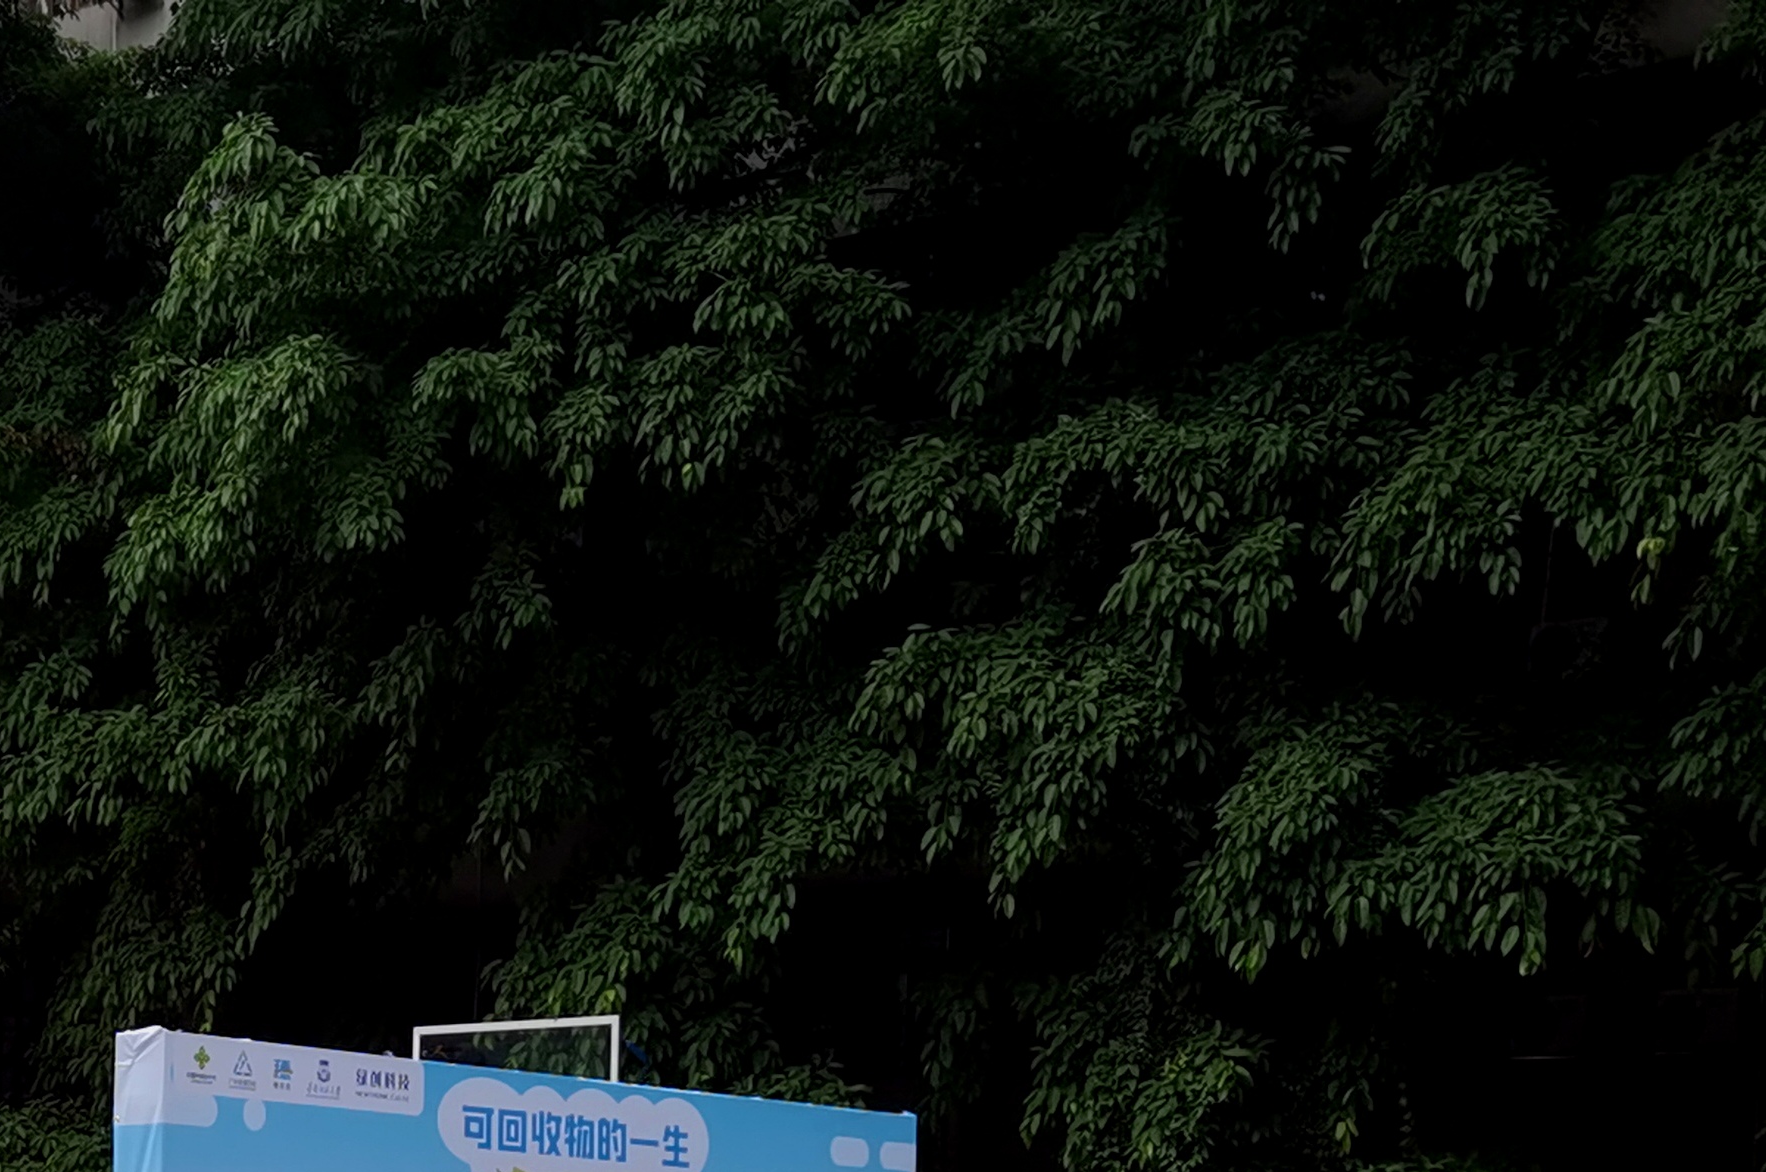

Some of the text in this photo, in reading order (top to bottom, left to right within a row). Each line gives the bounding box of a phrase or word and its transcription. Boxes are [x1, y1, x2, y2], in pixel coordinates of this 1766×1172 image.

[462, 1104, 690, 1169] 可回收物的一生
